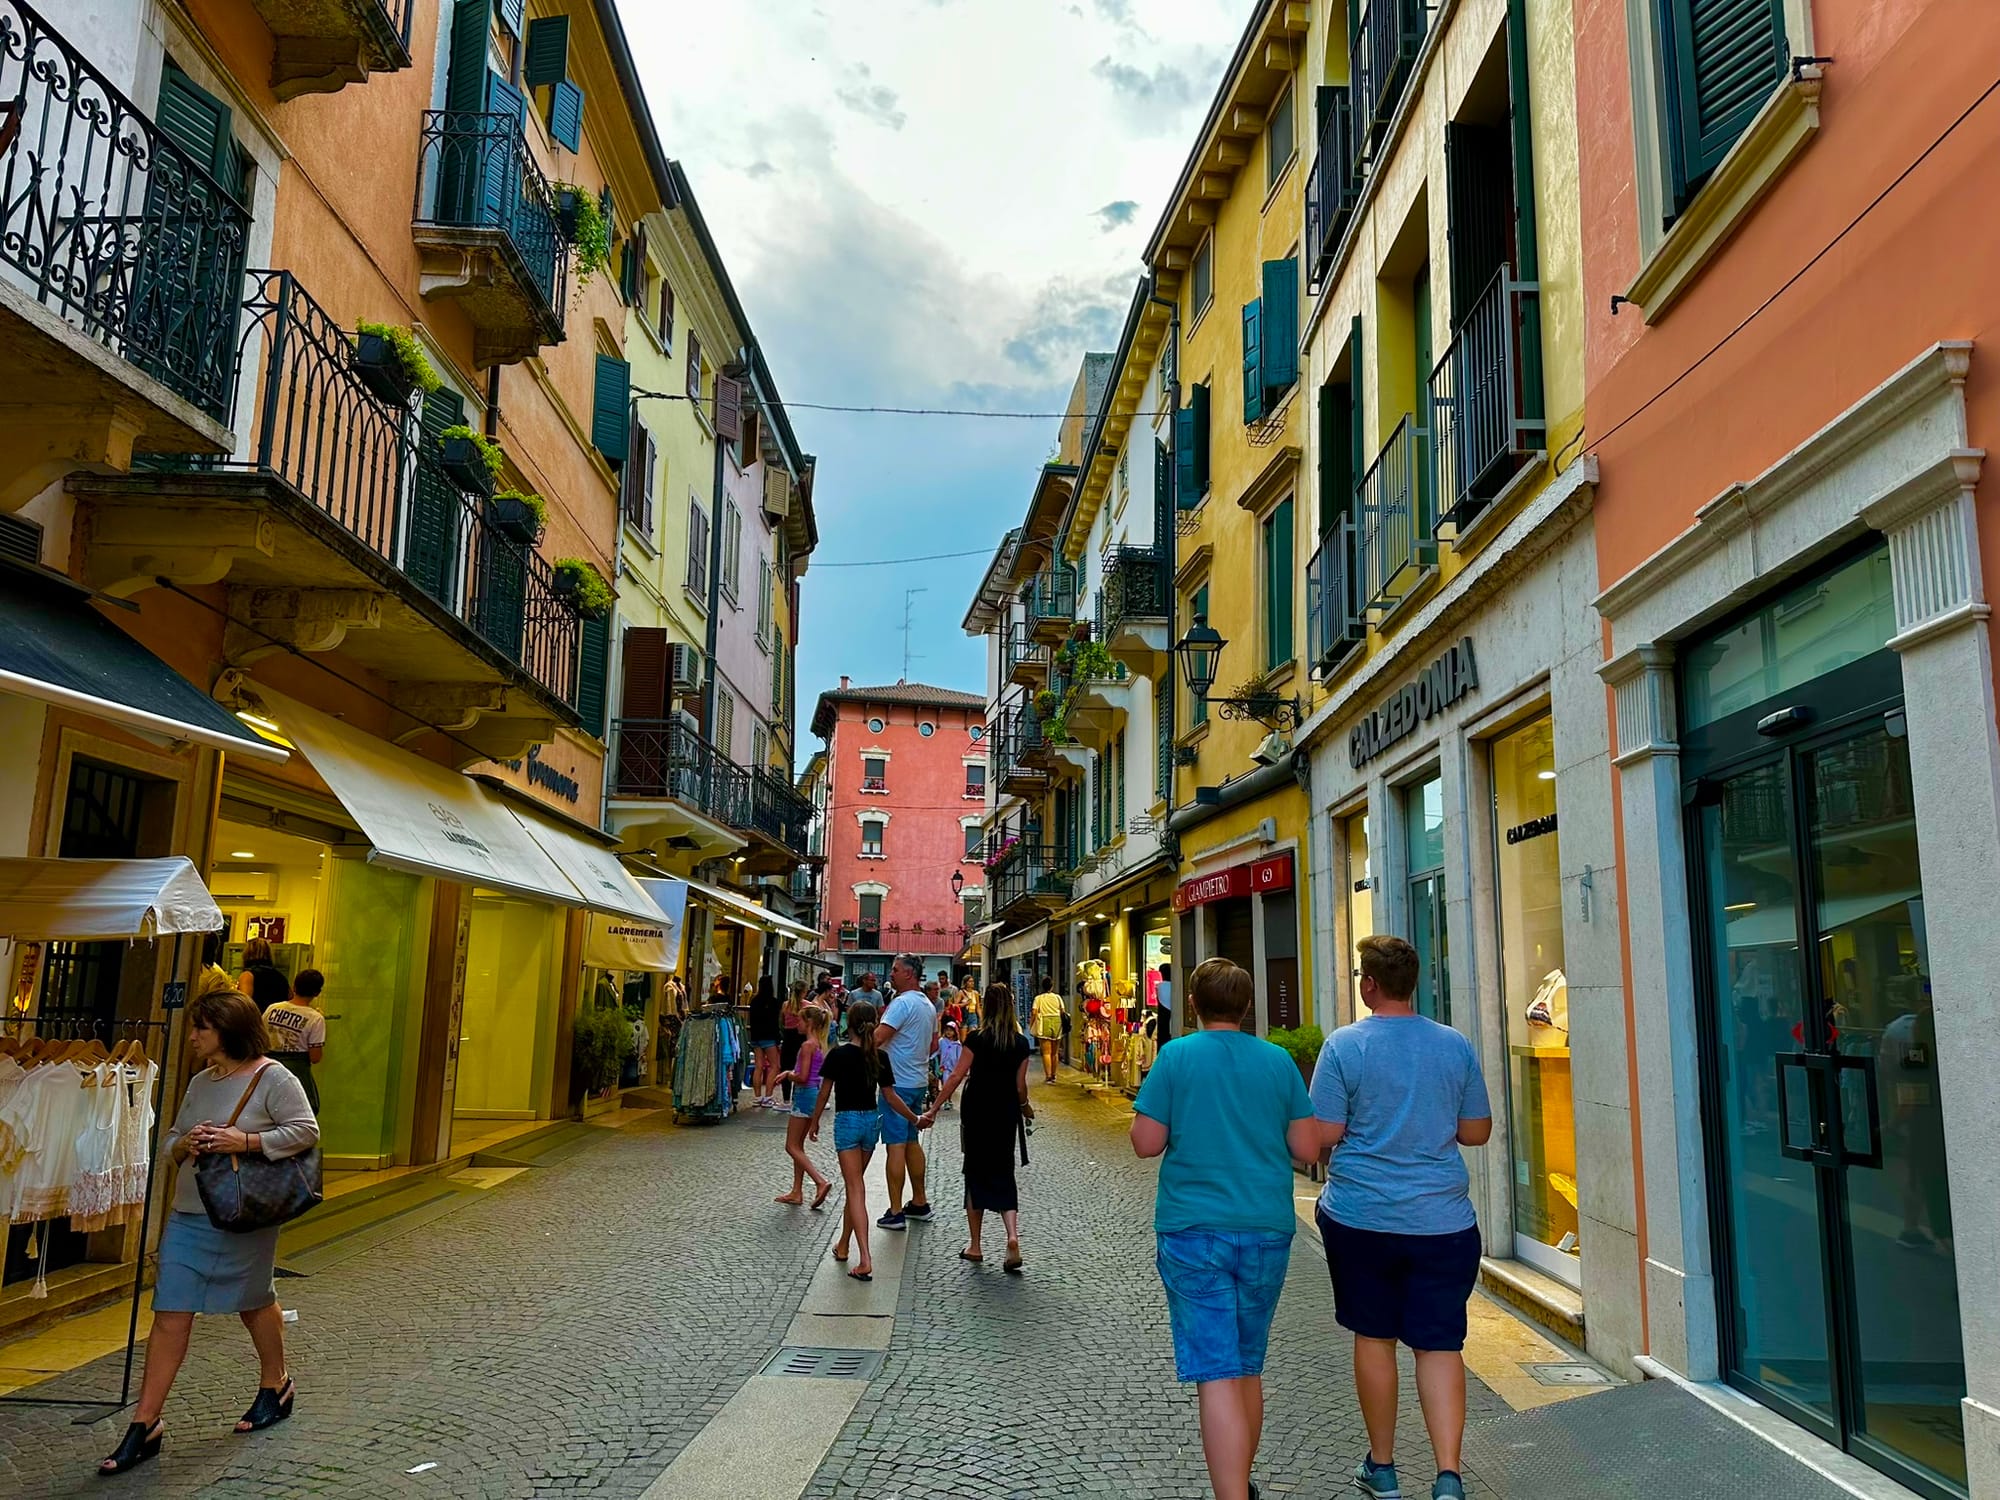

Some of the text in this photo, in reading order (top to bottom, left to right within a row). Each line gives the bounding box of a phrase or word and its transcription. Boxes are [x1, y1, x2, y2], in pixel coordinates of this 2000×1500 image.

[1348, 636, 1479, 769] CALZEDONIA
[1188, 874, 1230, 902] GIAMPIETRO
[607, 926, 664, 939] LACREMERIA
[268, 1008, 301, 1028] CHPTR
